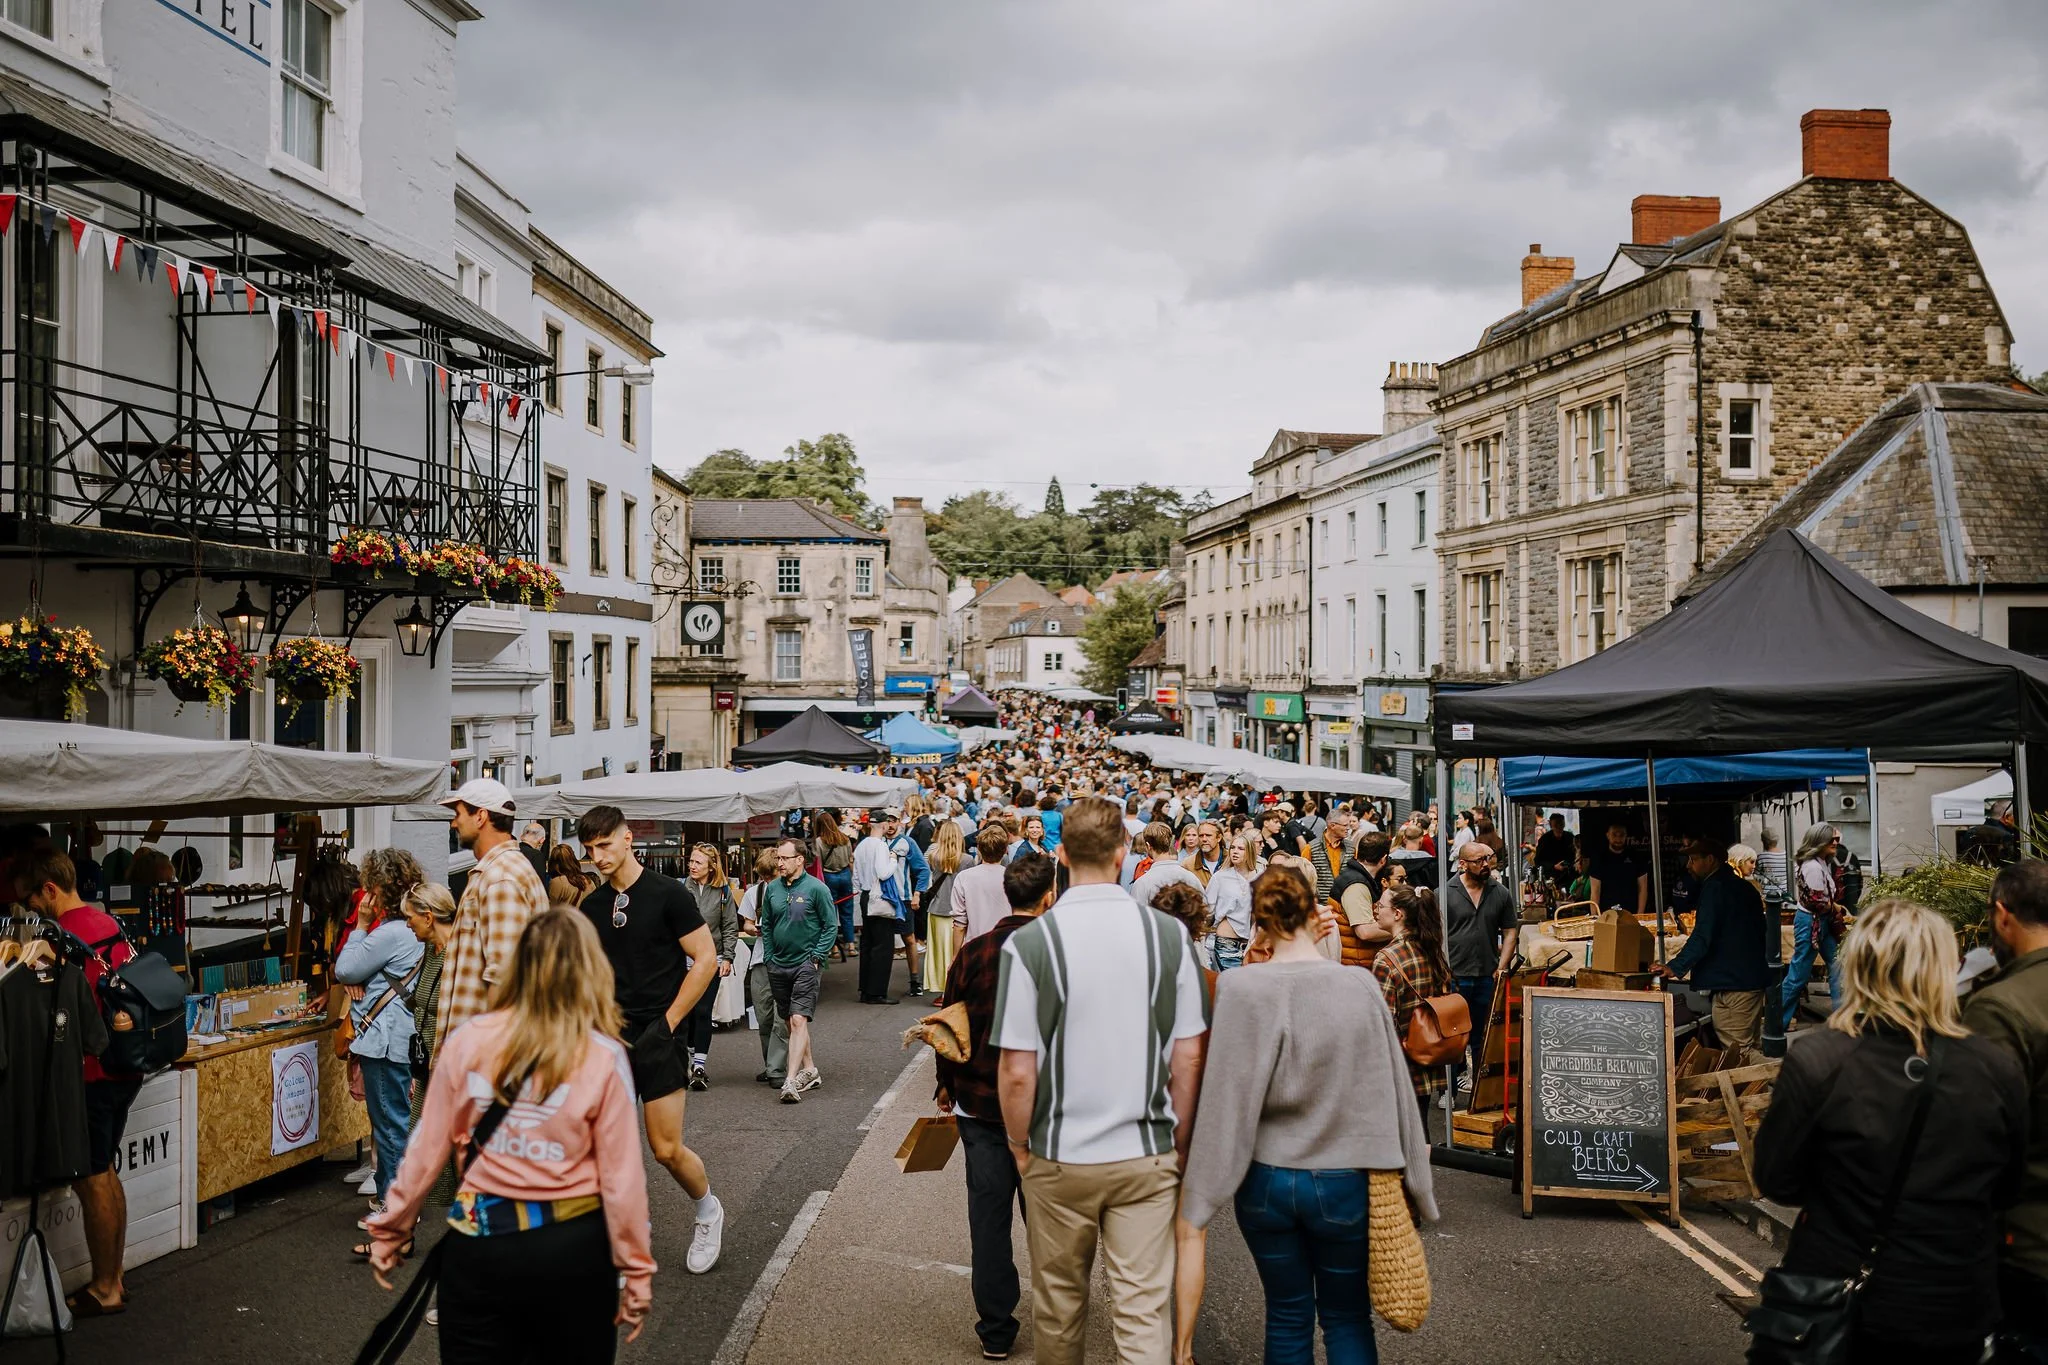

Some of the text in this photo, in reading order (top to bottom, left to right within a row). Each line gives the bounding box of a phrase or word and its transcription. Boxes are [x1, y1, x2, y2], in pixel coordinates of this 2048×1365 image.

[1591, 1044, 1608, 1053] THE
[1545, 1056, 1653, 1075] INCREDIBLE BREWING
[1580, 1078, 1622, 1087] COMPANY
[470, 1127, 565, 1161] didas
[1544, 1129, 1634, 1147] COLD CRAFT
[1571, 1147, 1630, 1172] BEERS
